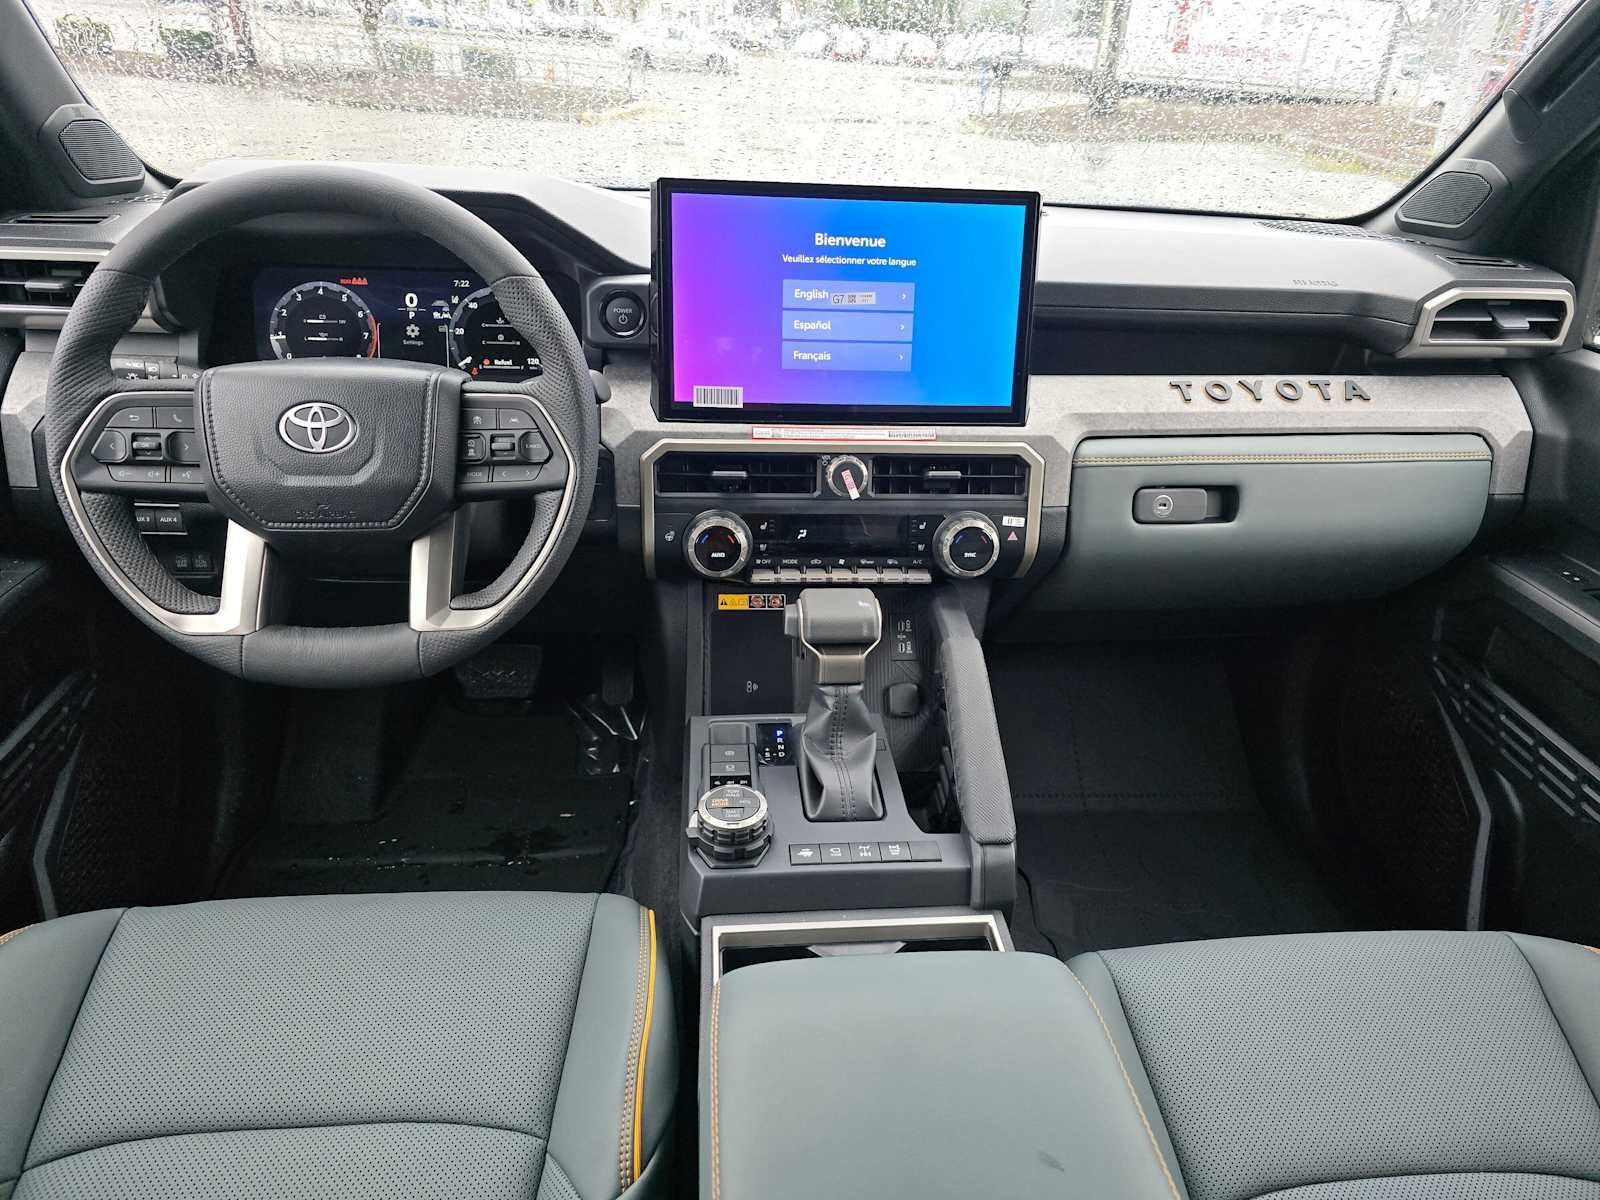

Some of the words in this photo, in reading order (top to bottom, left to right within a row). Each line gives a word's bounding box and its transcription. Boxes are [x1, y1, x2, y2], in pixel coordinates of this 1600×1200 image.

[814, 232, 887, 248] Bienvenue
[782, 254, 814, 264] Veuillez
[815, 254, 865, 265] sélectionner
[866, 258, 888, 266] votre
[888, 257, 917, 268] langue
[453, 280, 470, 288] 7:22
[341, 294, 348, 302] 5
[794, 288, 829, 301] English
[832, 294, 845, 304] G7
[405, 292, 418, 308] 0
[281, 309, 287, 317] 2
[408, 311, 415, 319] P
[793, 319, 832, 332] Español
[455, 327, 465, 335] 20
[363, 332, 369, 340] 7
[402, 339, 424, 347] Settings
[793, 350, 831, 362] Français
[527, 358, 540, 366] 120
[1169, 379, 1371, 403] TOYOTA
